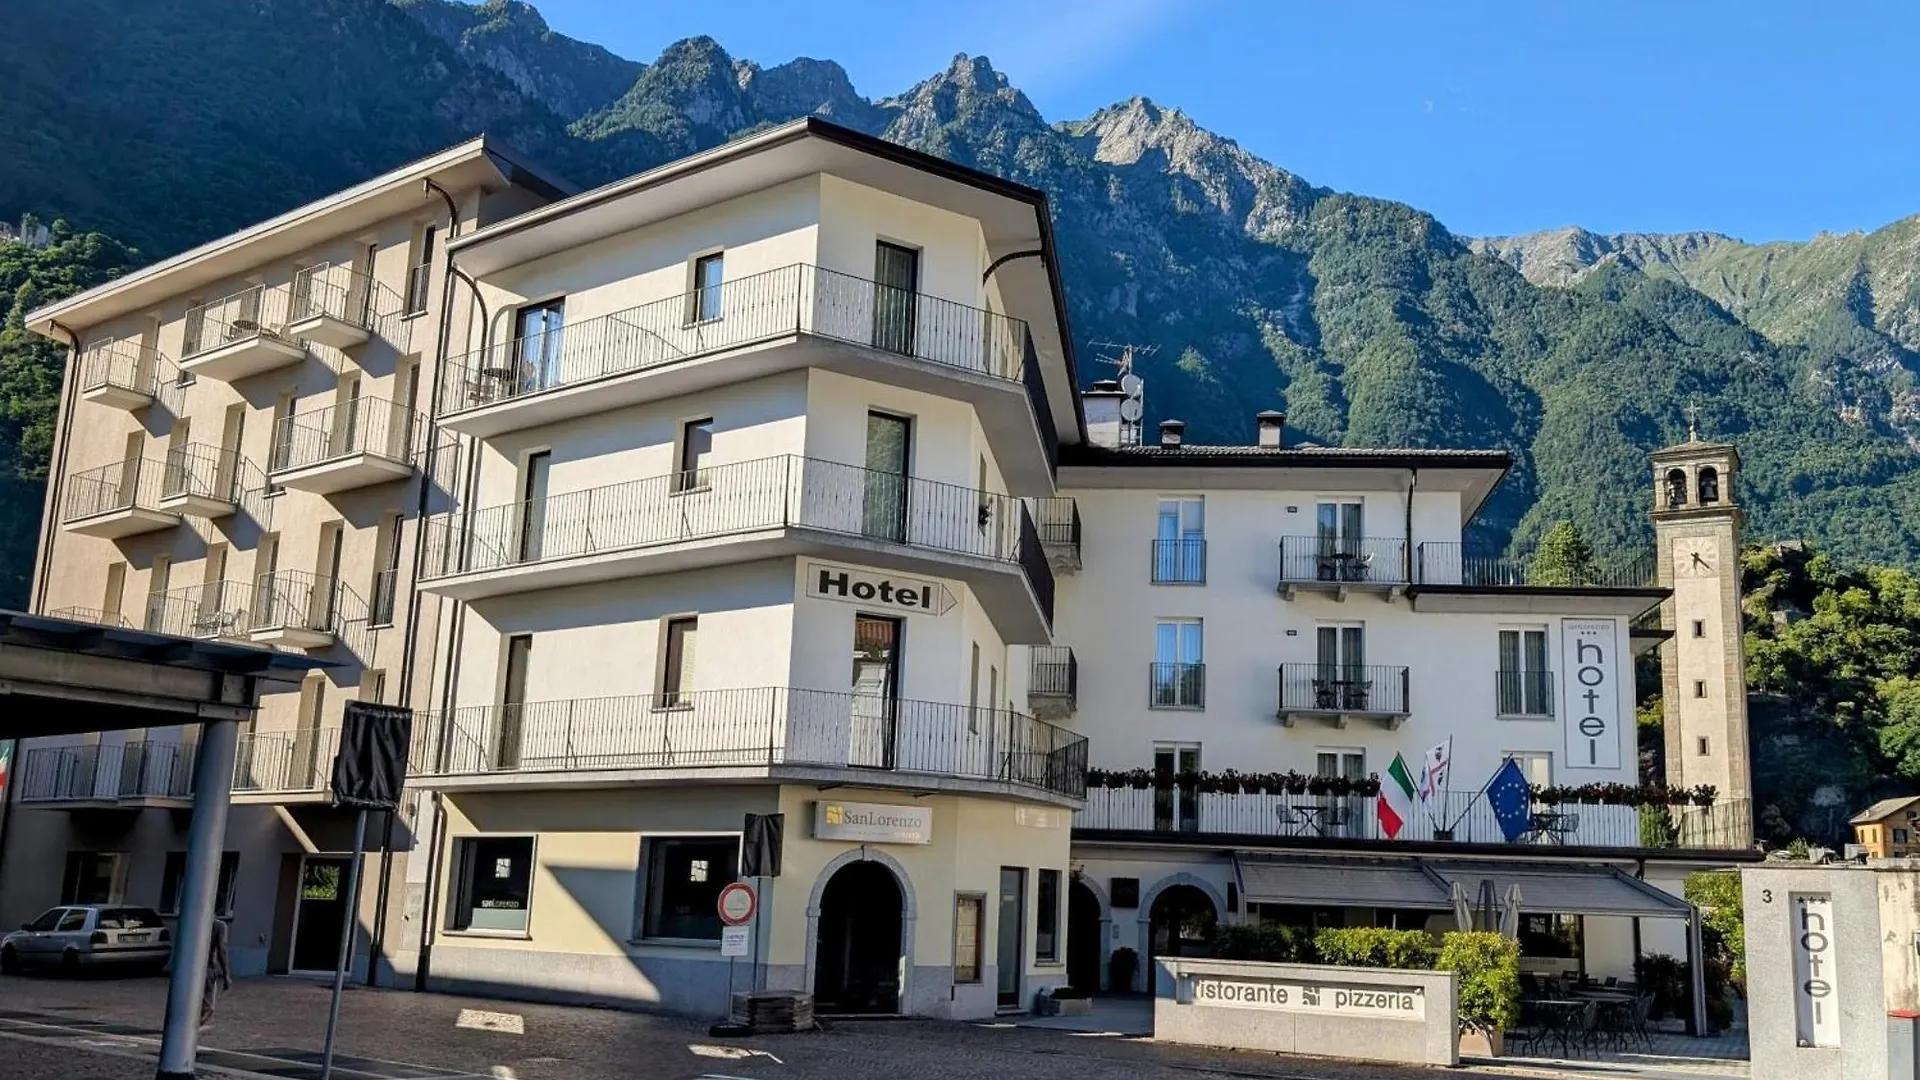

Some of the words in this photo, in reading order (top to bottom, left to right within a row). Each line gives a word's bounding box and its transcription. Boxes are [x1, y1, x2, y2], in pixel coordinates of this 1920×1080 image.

[819, 570, 931, 608] Hotel
[1577, 639, 1605, 765] hotel
[844, 810, 922, 828] SanLorenzo
[1762, 889, 1773, 904] 3
[1801, 908, 1831, 1025] hotel
[1335, 988, 1414, 1010] pizzeria
